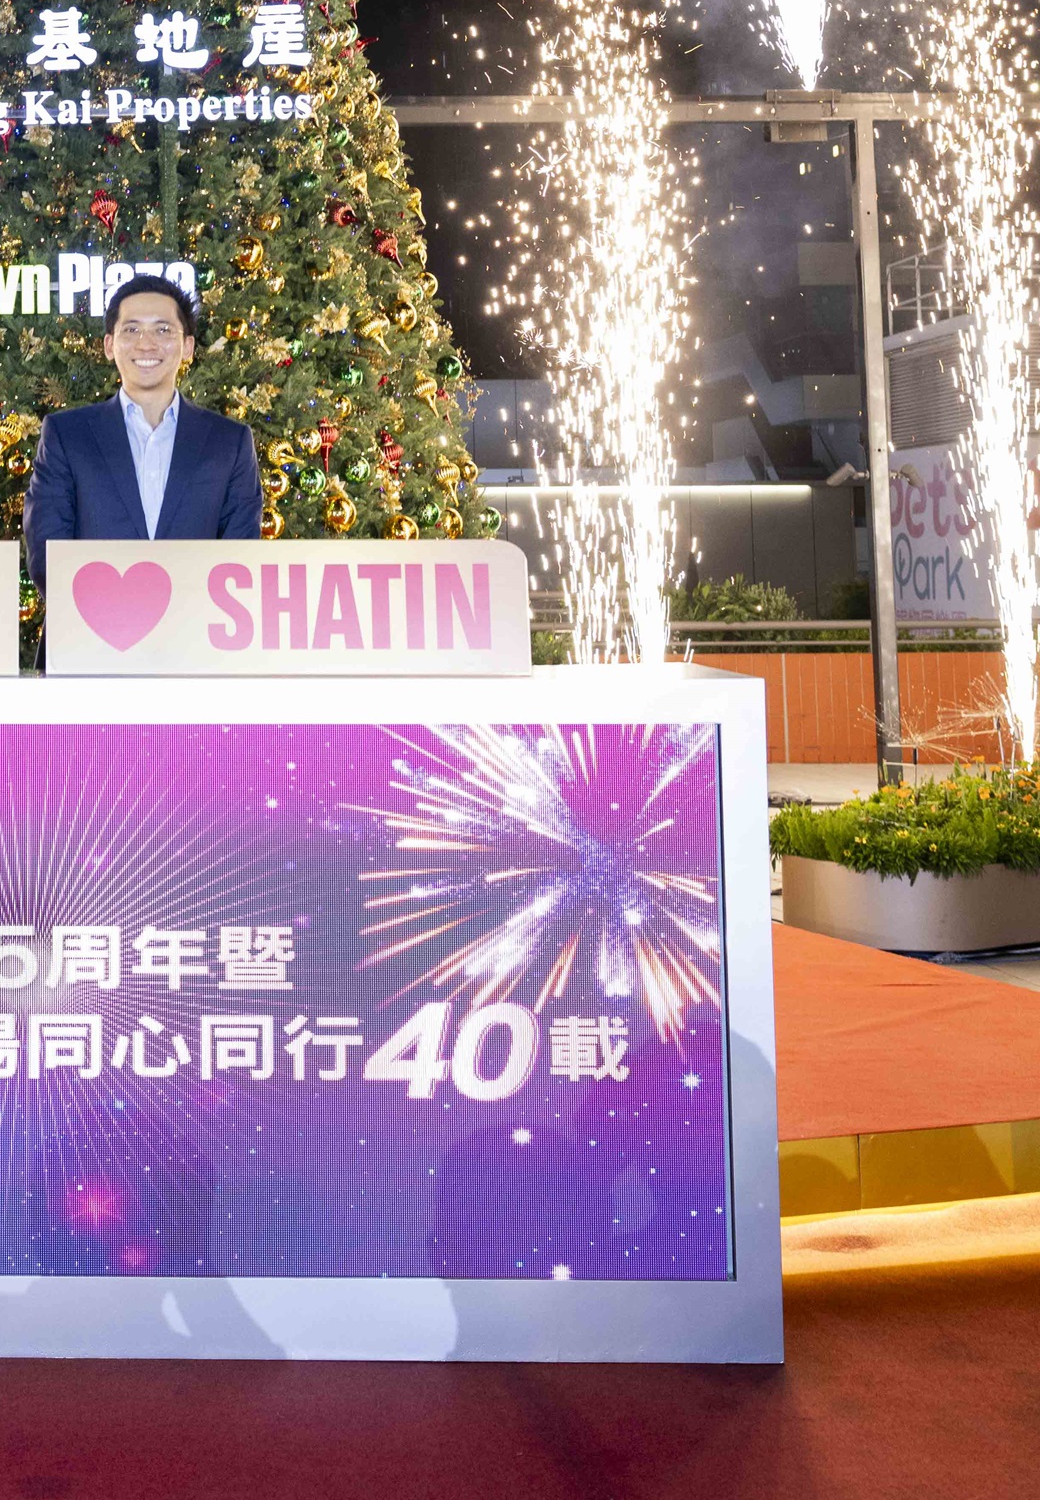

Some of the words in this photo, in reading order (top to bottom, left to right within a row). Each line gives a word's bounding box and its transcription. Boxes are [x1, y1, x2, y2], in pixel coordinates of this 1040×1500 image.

[22, 89, 92, 126] Kai
[105, 86, 313, 131] Properties
[58, 252, 196, 317] Pla
[207, 562, 492, 650] SHATIN
